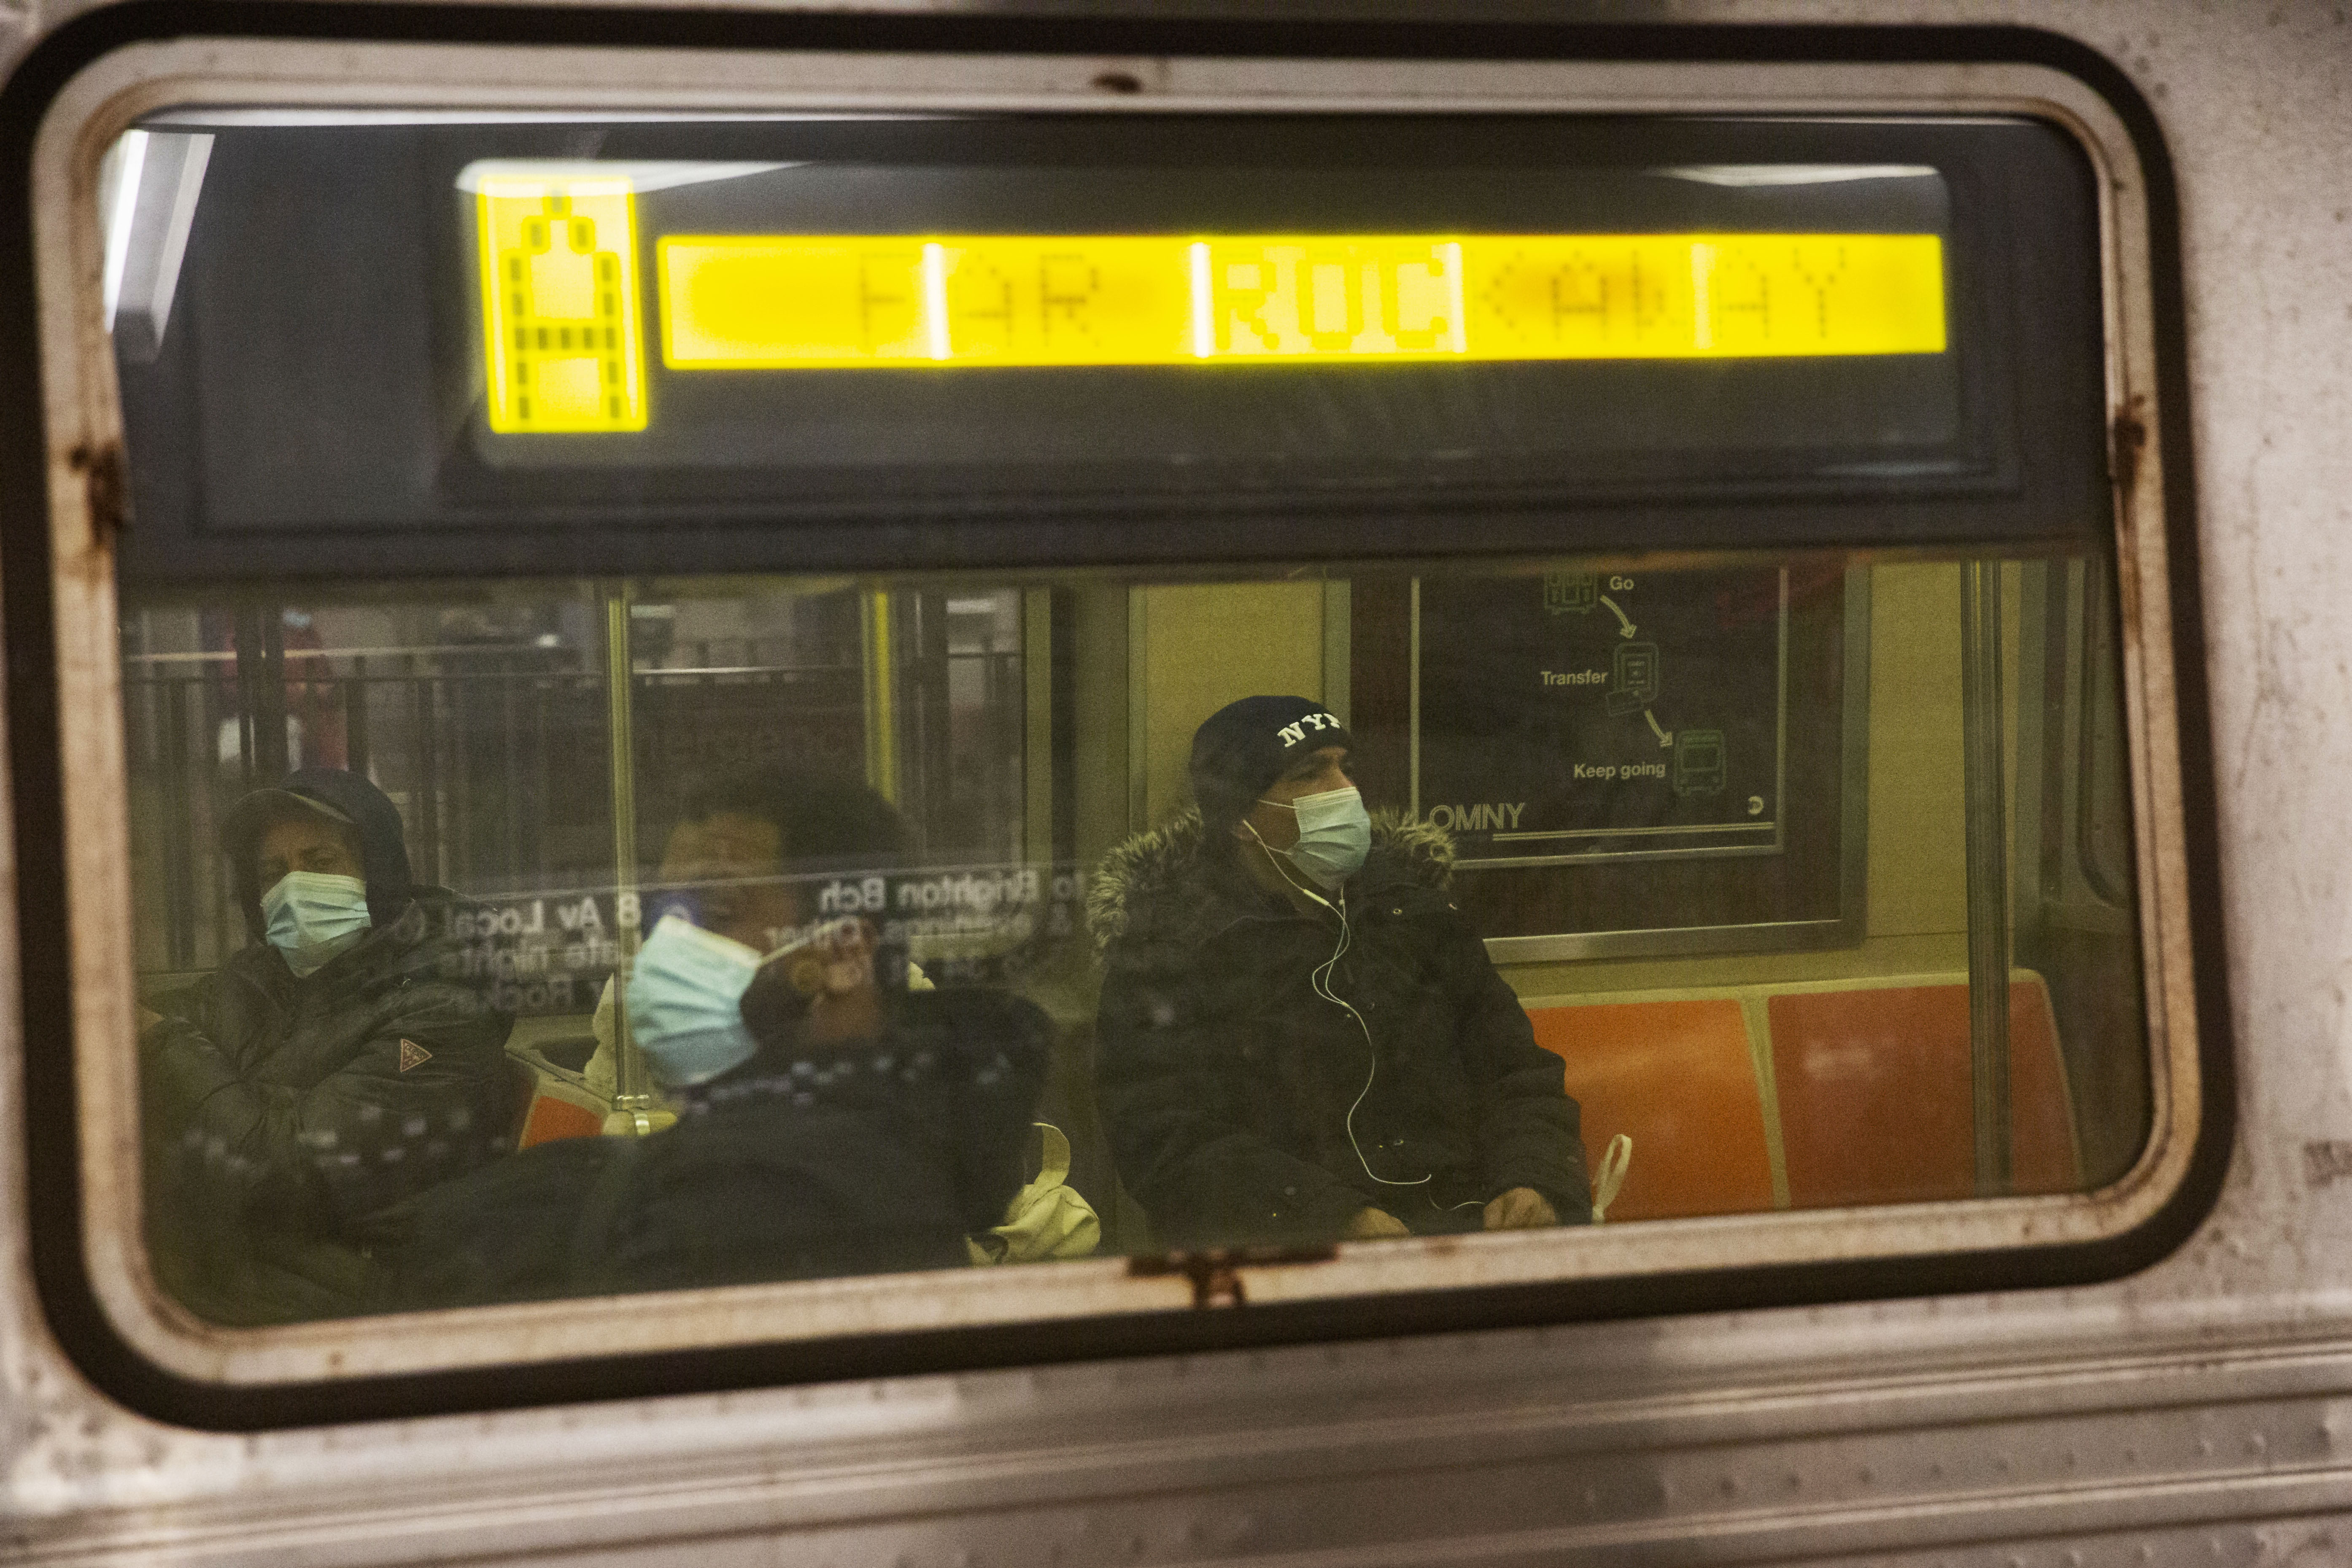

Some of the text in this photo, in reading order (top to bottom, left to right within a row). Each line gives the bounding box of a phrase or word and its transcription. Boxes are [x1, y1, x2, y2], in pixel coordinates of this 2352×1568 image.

[507, 186, 624, 423] A
[858, 250, 1102, 349] FAR
[1609, 575, 1635, 591] Go
[1541, 669, 1608, 685] Transfer
[1574, 762, 1666, 780] Keep going
[1430, 802, 1525, 831] OMNY
